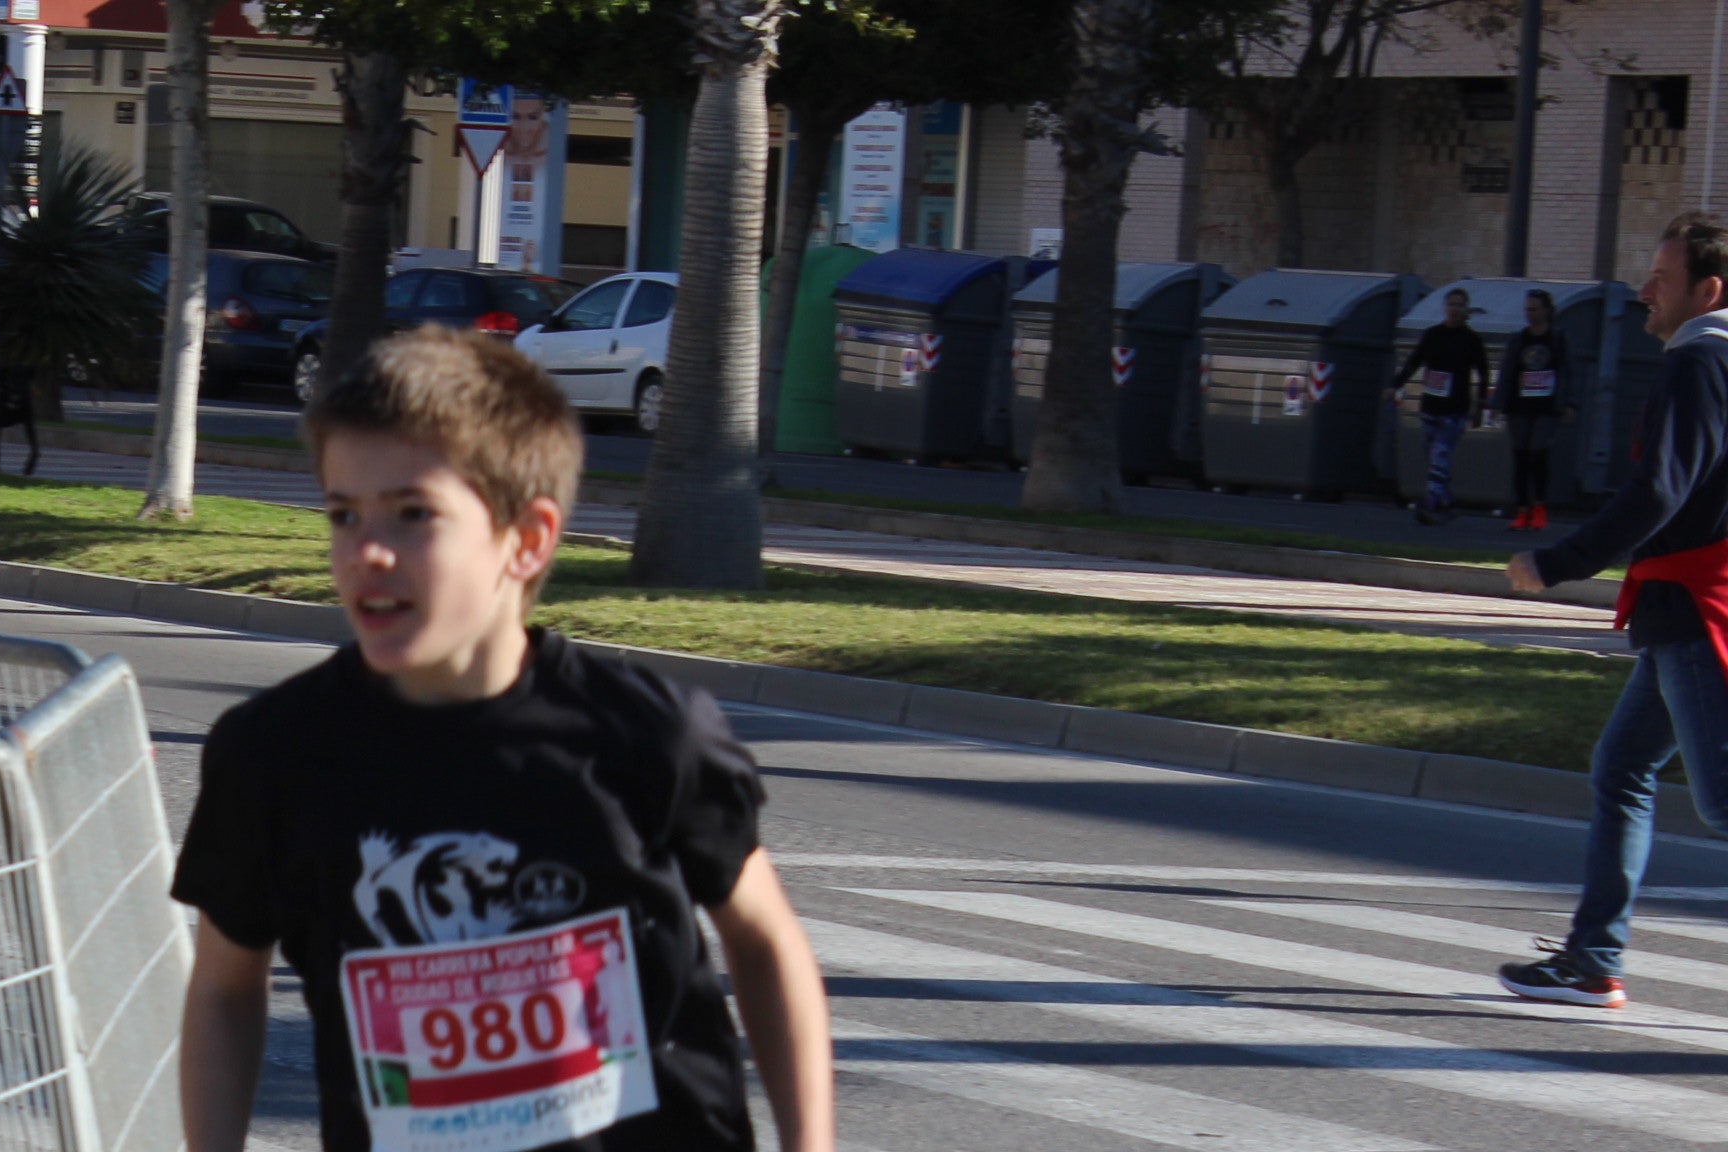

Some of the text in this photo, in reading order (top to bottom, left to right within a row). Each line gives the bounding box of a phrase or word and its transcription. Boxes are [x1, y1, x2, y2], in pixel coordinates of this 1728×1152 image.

[416, 951, 492, 979] CARRERA
[494, 934, 576, 969] POPULAR
[389, 978, 452, 1003] CIUDAD
[455, 978, 476, 999] DE
[420, 992, 566, 1071] 980
[409, 1077, 610, 1133] meetingpoint
